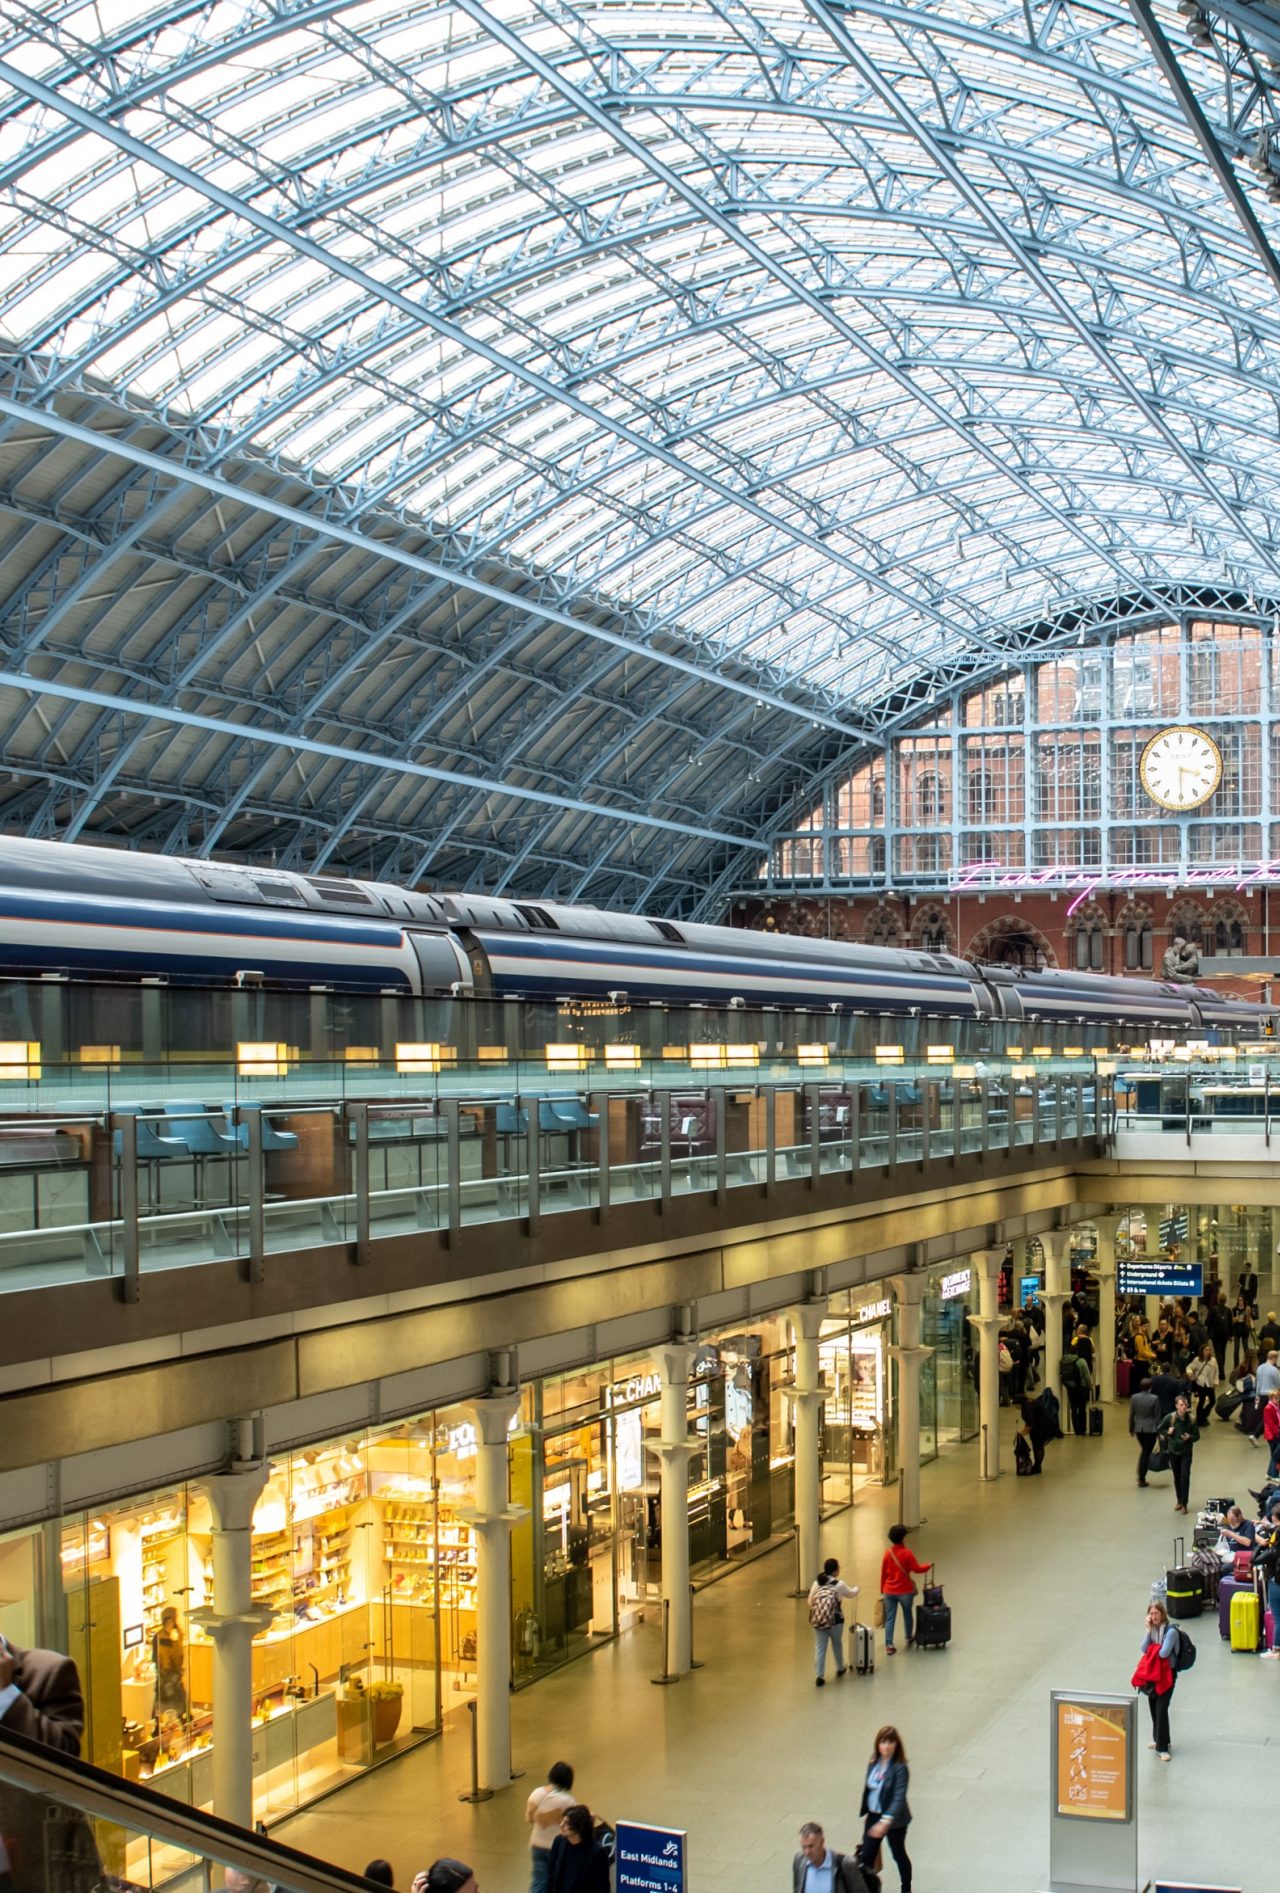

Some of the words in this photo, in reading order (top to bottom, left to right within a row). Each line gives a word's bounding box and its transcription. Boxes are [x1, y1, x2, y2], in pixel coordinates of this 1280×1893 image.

[859, 1298, 892, 1322] CHANEL
[620, 1850, 639, 1862] East
[640, 1853, 678, 1869] Midlands
[620, 1874, 662, 1891] Platforms
[663, 1882, 678, 1893] 1-4
